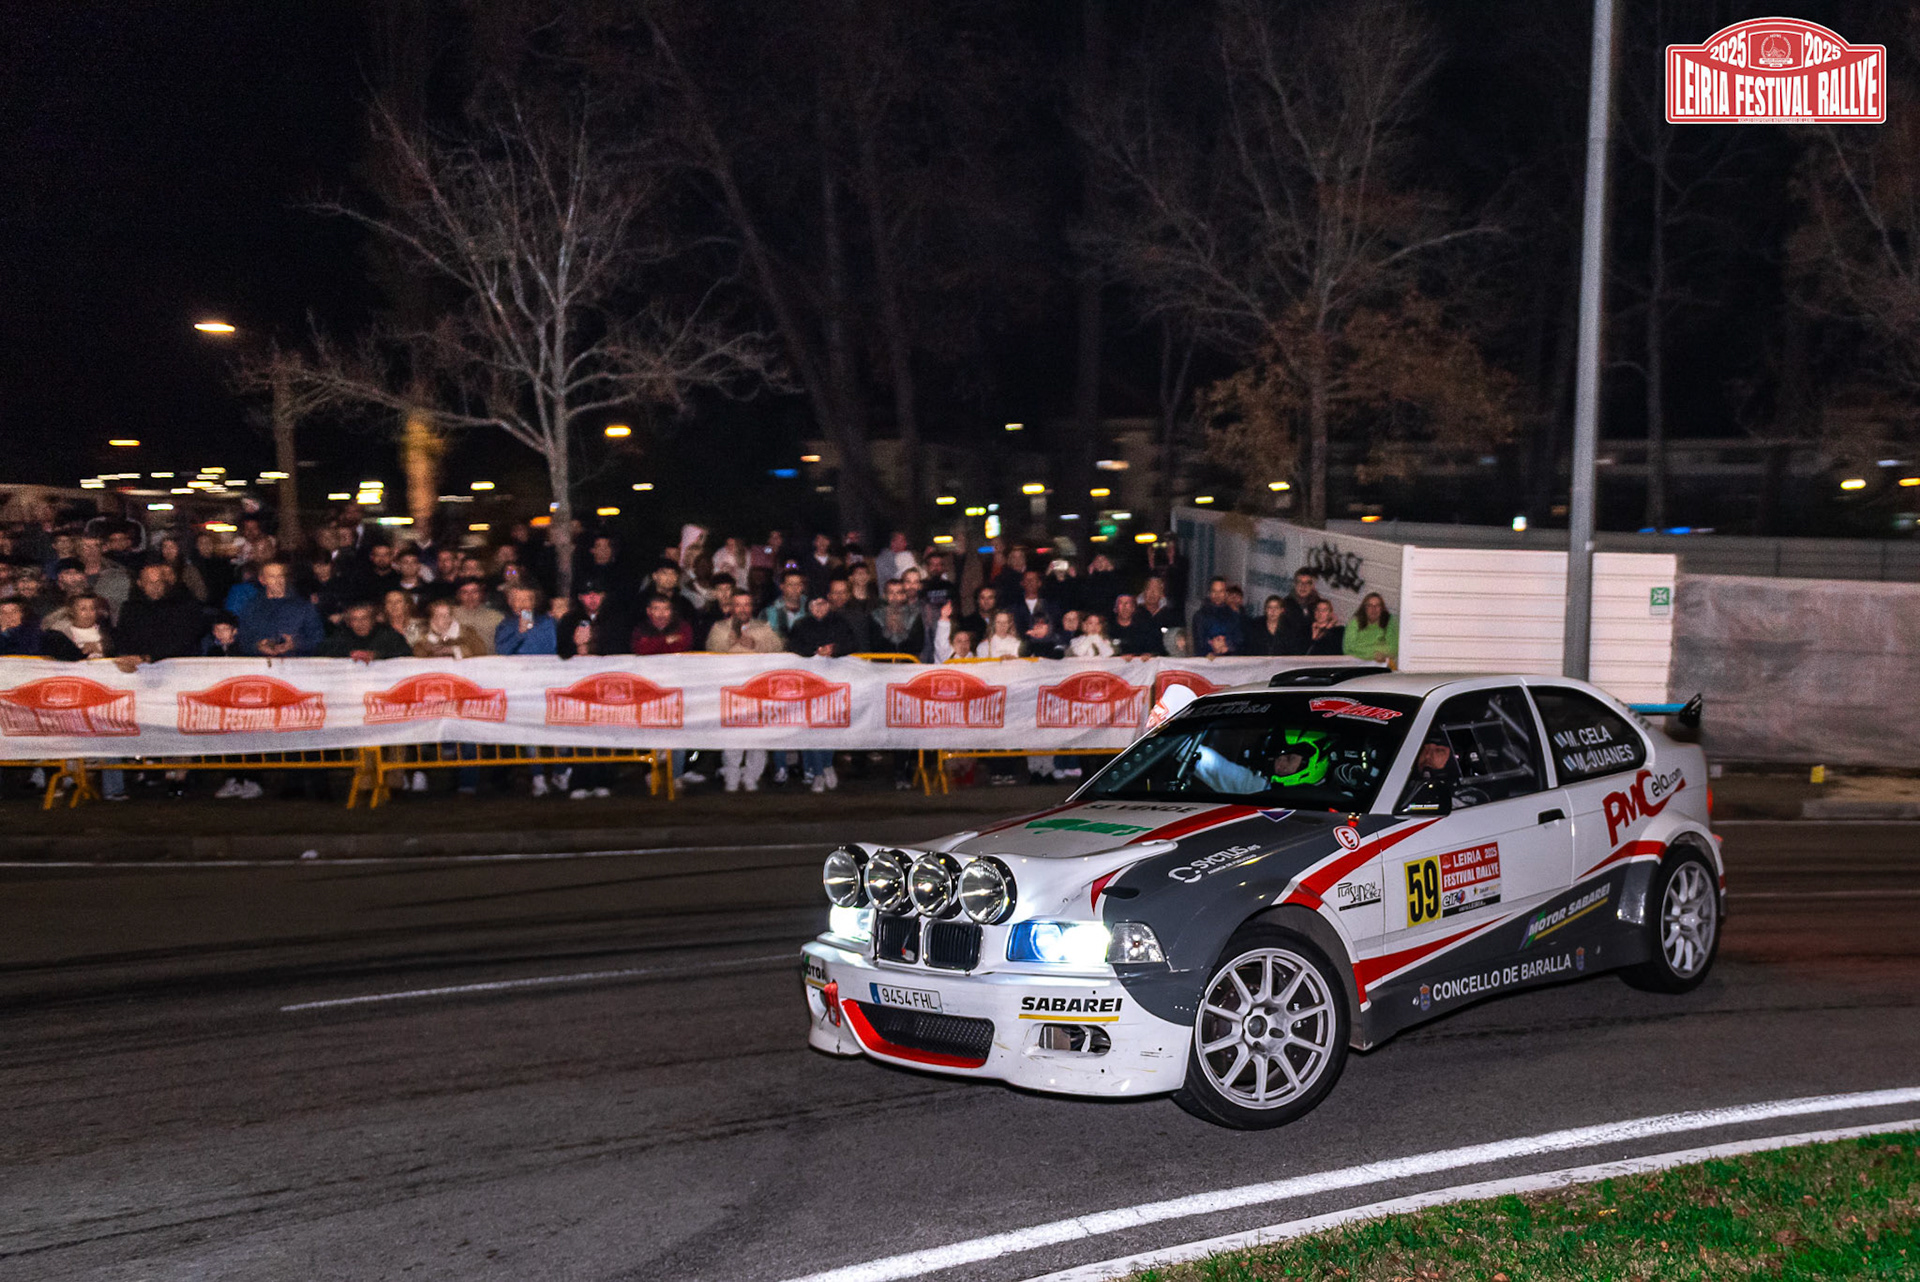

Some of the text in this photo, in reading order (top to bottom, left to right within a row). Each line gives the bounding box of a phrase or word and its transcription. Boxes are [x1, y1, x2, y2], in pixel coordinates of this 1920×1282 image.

[923, 701, 965, 724] FESTIVAL
[1578, 725, 1613, 745] CELA
[1453, 849, 1483, 868] LEIRIA
[1443, 862, 1499, 888] FESTIVAL RALLYE
[1407, 860, 1440, 923] 59
[1528, 882, 1611, 937] MOTOR SABAREI
[1432, 953, 1572, 1001] CONCELLO DE BARALLA
[1020, 995, 1124, 1014] SABAREI
